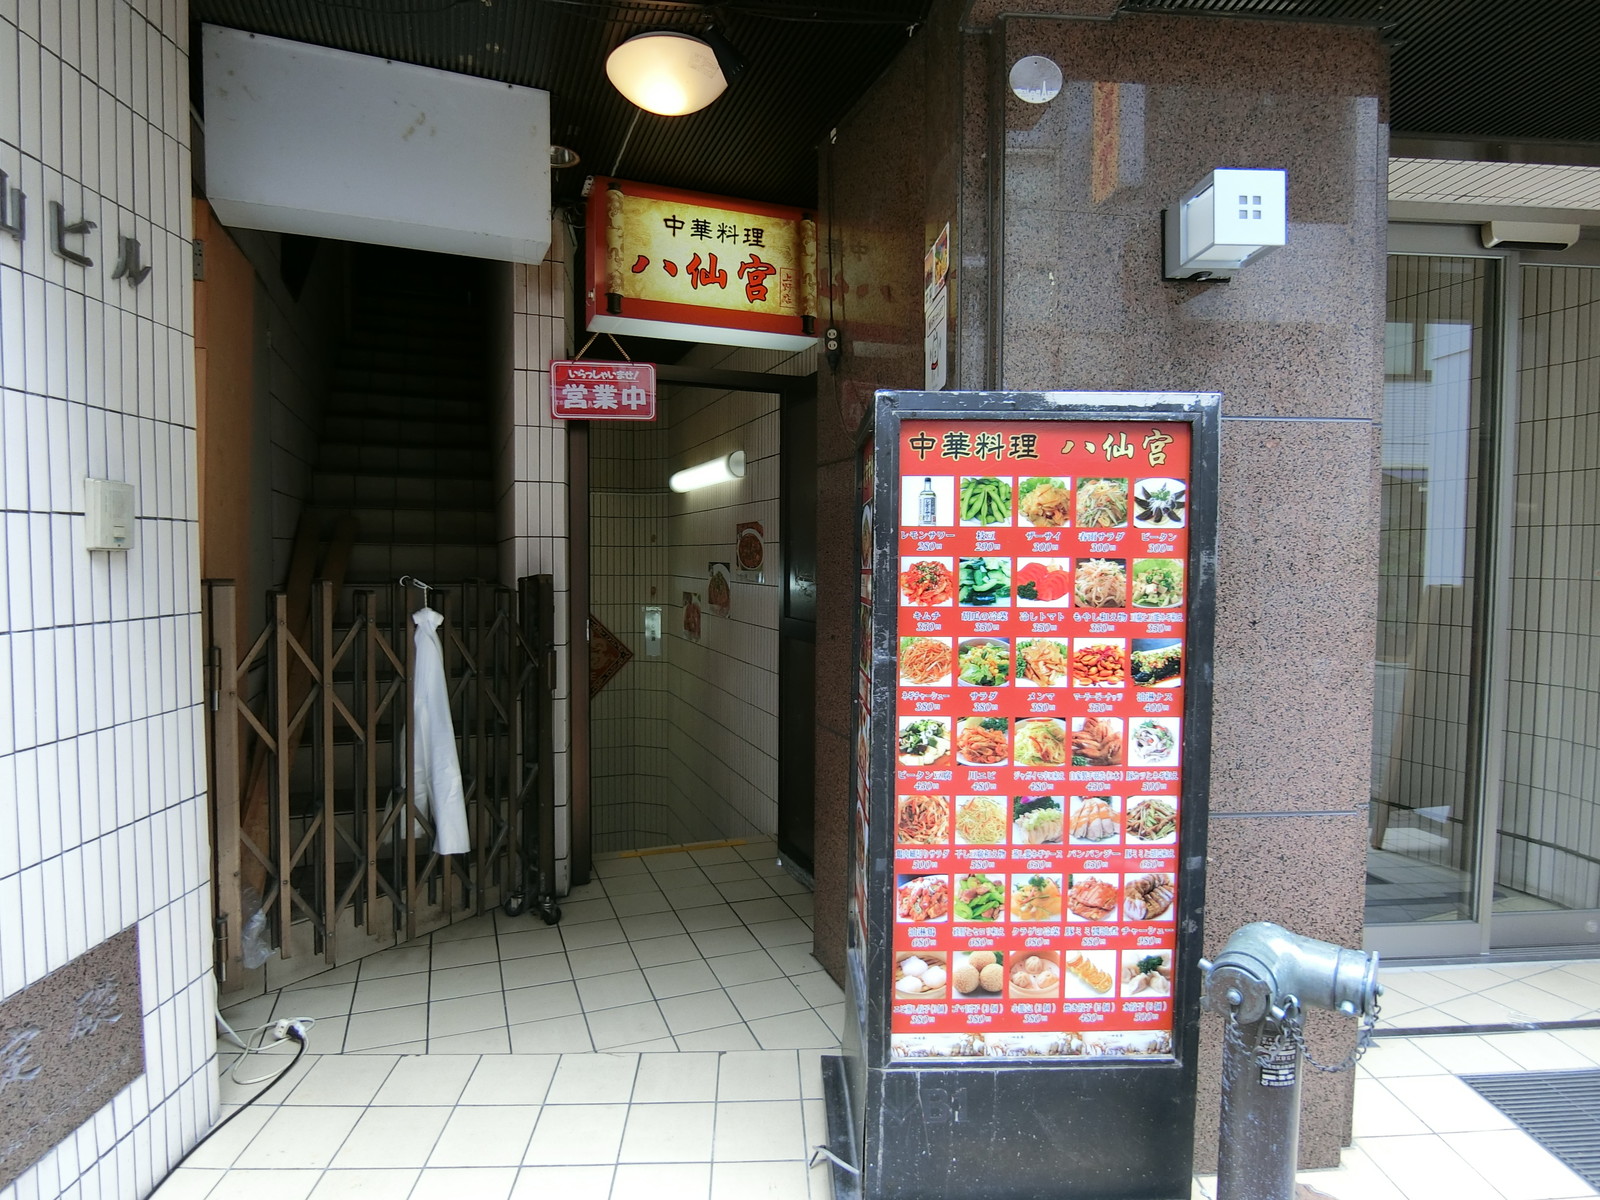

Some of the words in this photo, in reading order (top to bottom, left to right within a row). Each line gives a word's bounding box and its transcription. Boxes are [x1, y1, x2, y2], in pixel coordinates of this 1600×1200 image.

[663, 214, 766, 248] 中華料理
[631, 252, 777, 303] 八仙宮
[562, 384, 647, 410] 営業中
[908, 430, 1040, 462] 中華料理
[1060, 428, 1175, 468] 八仙宮
[901, 530, 955, 540] レモンサワー
[975, 529, 996, 541] 枝豆
[1025, 530, 1061, 541] ザーサイ
[917, 541, 942, 551] 280円
[1032, 542, 1059, 552] 300円
[1090, 543, 1116, 552] 300円
[1147, 543, 1173, 553] 300円
[913, 610, 941, 621] キムチ
[1019, 610, 1064, 622] 冷しトマト
[1073, 611, 1128, 622] もやし和え物
[969, 690, 998, 701] サラダ
[1027, 691, 1055, 701] メンマ
[972, 702, 998, 712] 380円
[967, 770, 997, 780] 川エビ
[1121, 925, 1174, 935] チャーシュー
